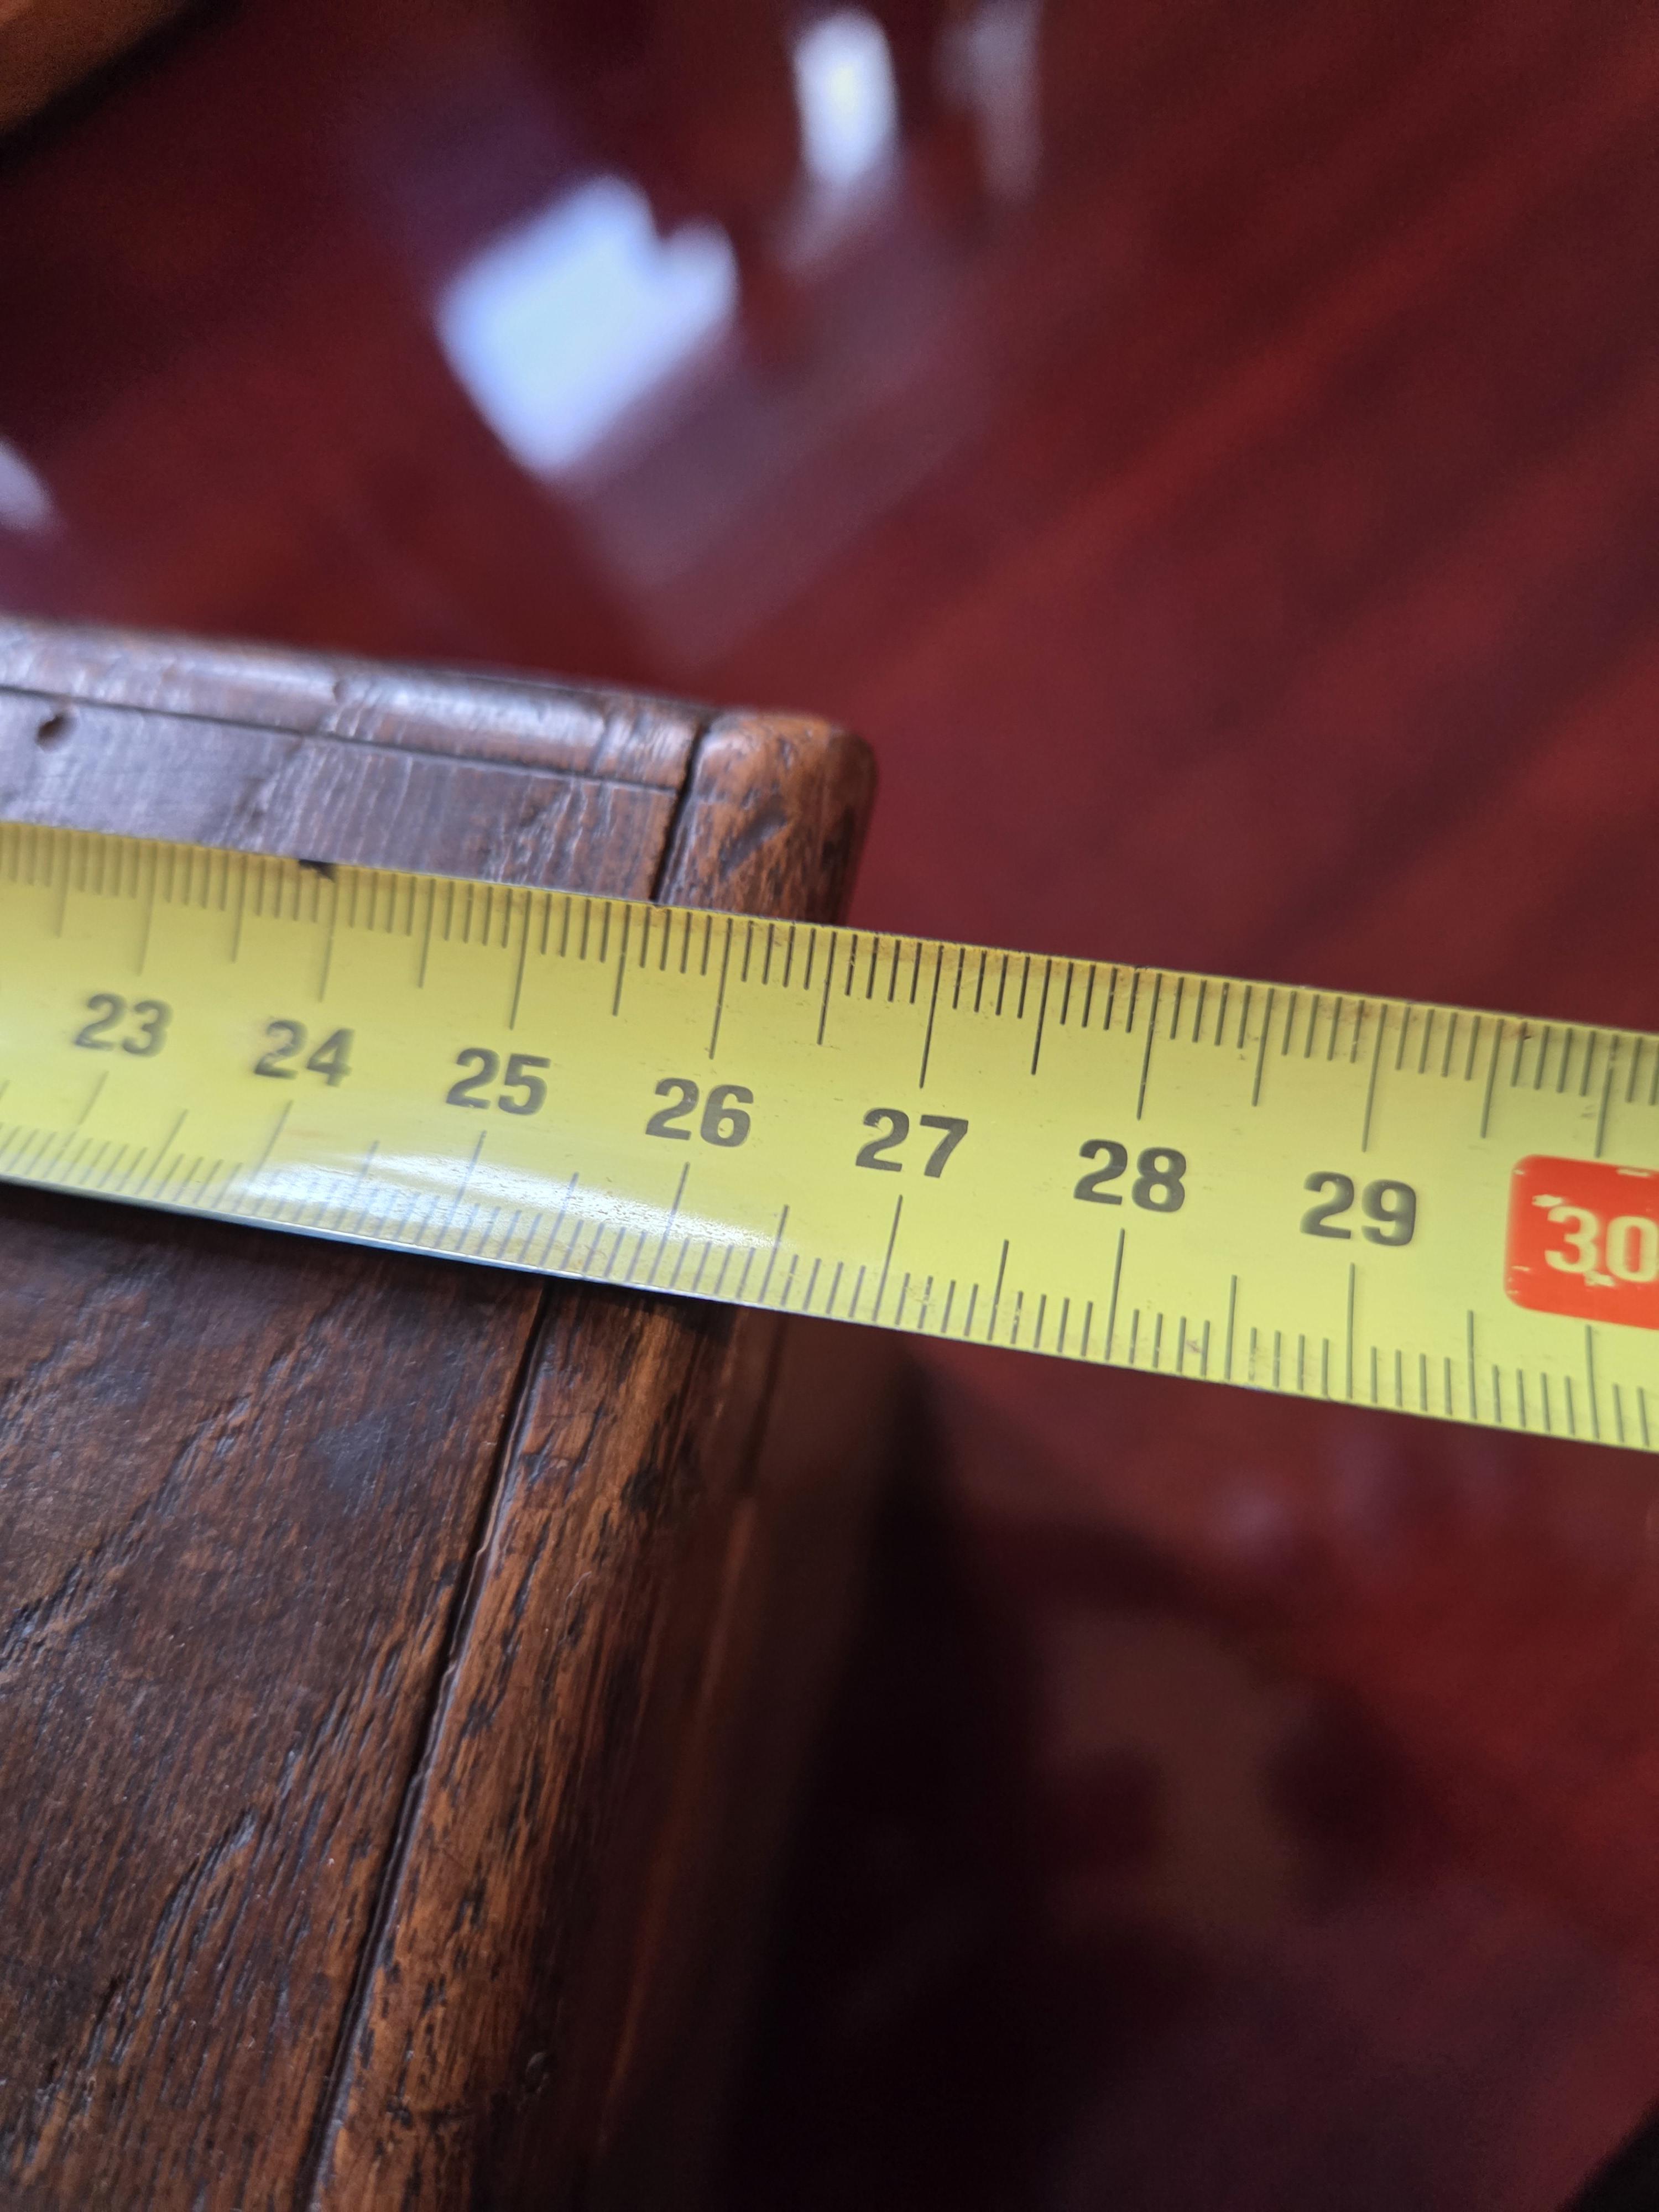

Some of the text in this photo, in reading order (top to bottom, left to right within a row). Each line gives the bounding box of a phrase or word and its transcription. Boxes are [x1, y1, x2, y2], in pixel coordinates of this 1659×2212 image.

[74, 993, 1659, 1283] 23 24 25 26 27 28 29 30
